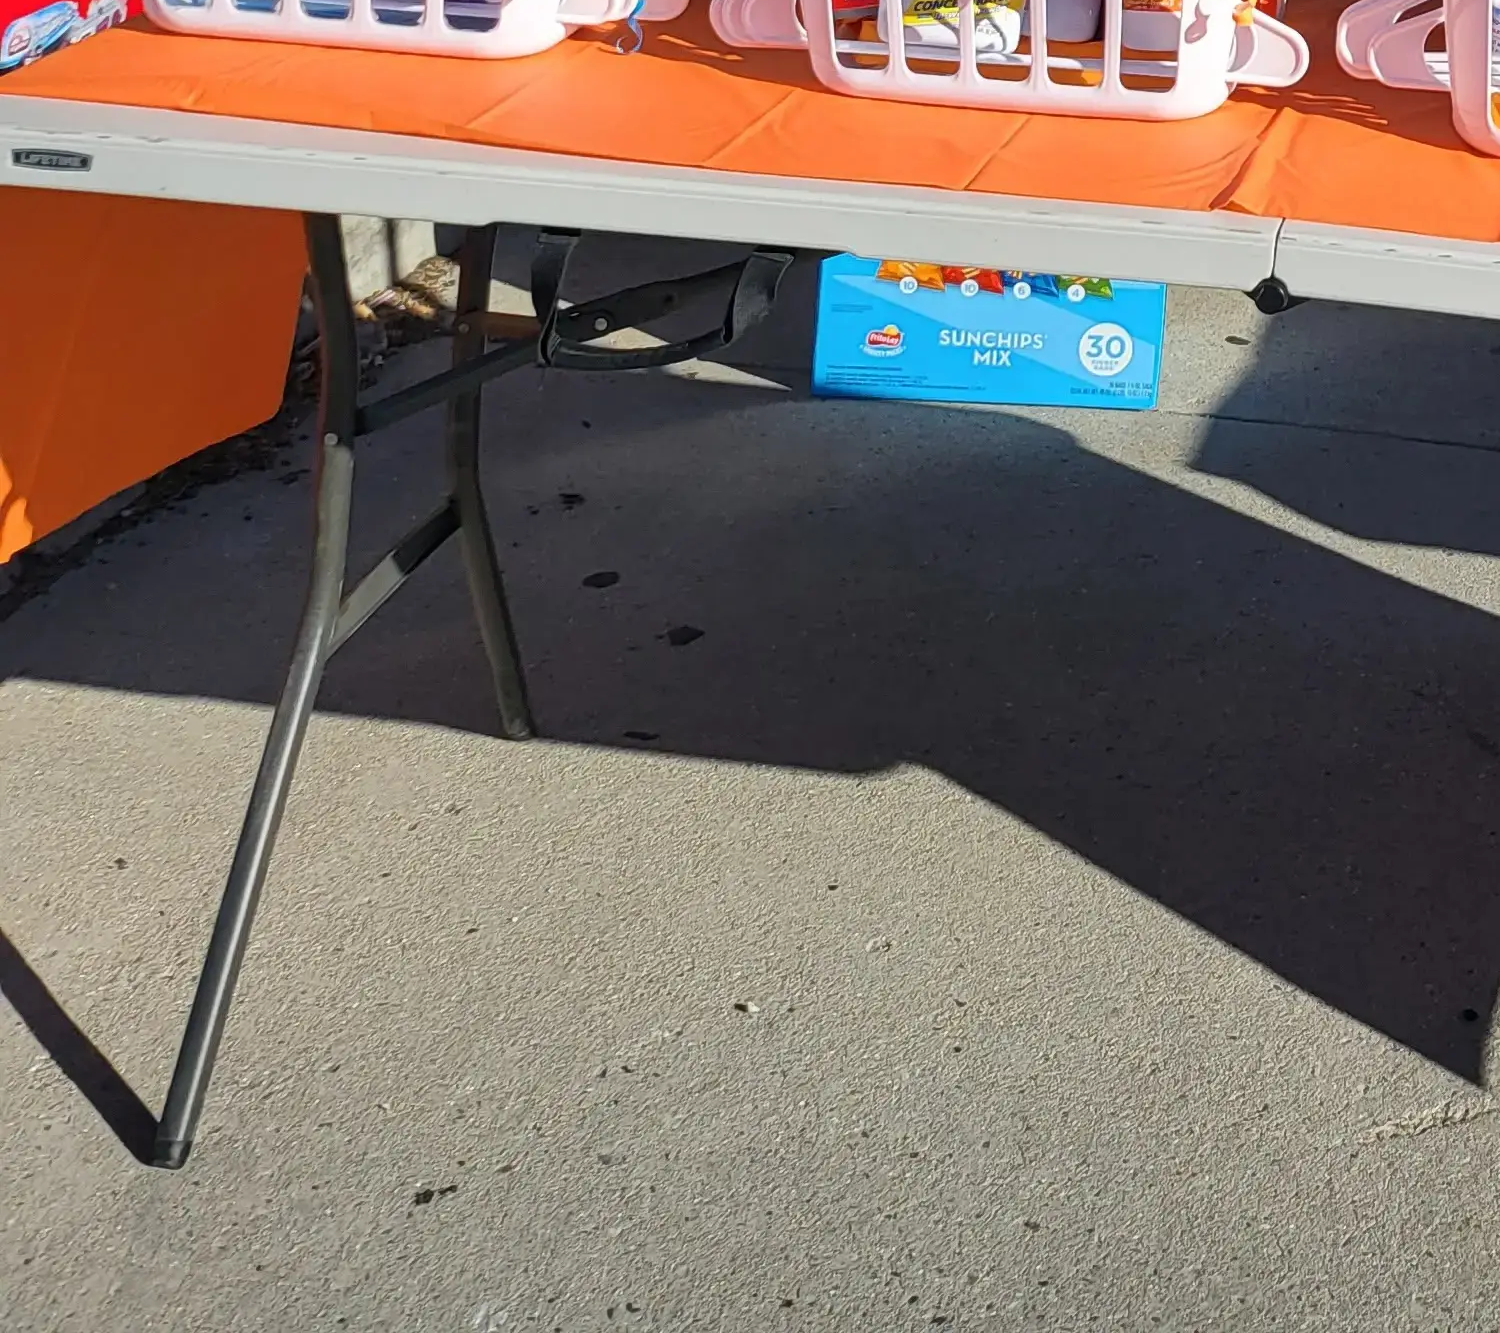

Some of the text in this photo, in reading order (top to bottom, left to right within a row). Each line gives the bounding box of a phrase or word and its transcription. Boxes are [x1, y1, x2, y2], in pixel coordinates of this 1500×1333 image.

[903, 281, 915, 290] 10
[964, 283, 976, 292] 10
[1072, 288, 1080, 298] 4
[939, 329, 1043, 349] SUNCHIPS
[1085, 334, 1126, 359] 30
[973, 349, 1011, 367] MIX
